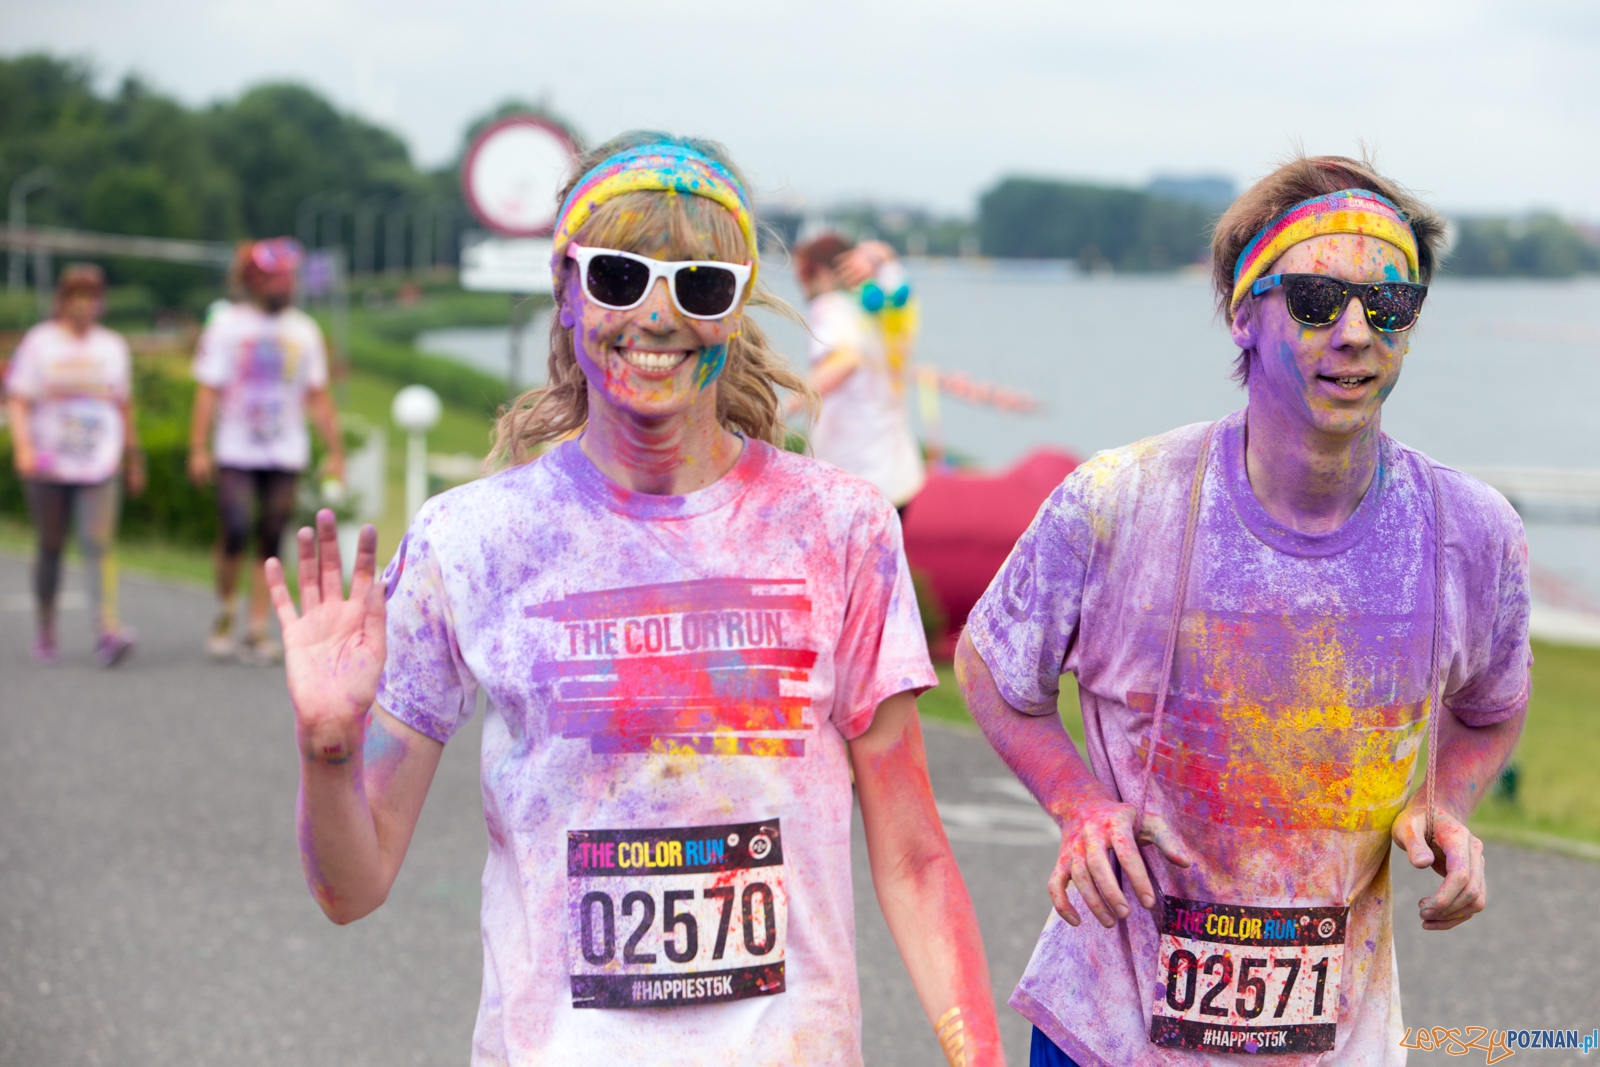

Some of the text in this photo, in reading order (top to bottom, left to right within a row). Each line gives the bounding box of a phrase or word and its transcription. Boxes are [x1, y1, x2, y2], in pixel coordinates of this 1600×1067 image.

[563, 620, 618, 655] THE
[624, 612, 719, 654] COLOR
[579, 842, 616, 868] THE
[618, 841, 683, 868] COLOR
[580, 882, 776, 966] 02570
[1175, 908, 1206, 934] THE
[1205, 913, 1262, 940] COLOR
[632, 975, 733, 1001] #HAPPIEST5K
[1166, 949, 1329, 1019] 02571
[1203, 1029, 1288, 1047] #HAPPIEST5K
